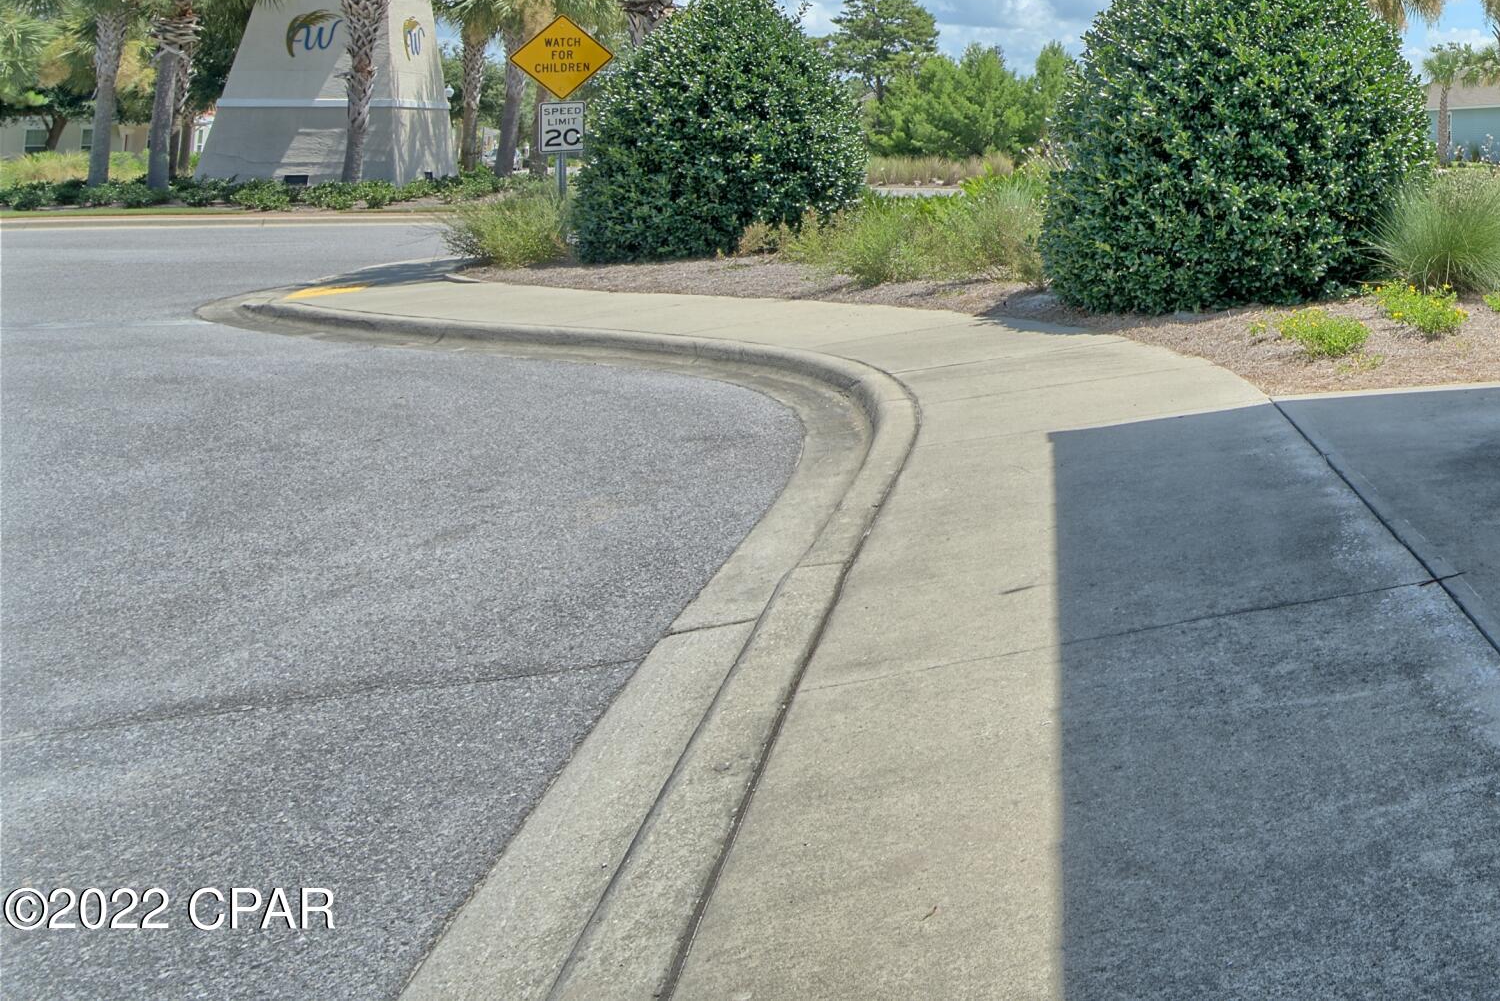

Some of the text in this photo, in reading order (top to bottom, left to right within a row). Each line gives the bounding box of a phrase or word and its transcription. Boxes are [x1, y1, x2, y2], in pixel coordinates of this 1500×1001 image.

[545, 38, 581, 47] WATCH
[552, 50, 573, 60] FOR
[535, 63, 590, 73] CHILDREN
[544, 107, 581, 115] SPEED
[548, 118, 577, 126] LIMIT
[545, 128, 581, 147] 20
